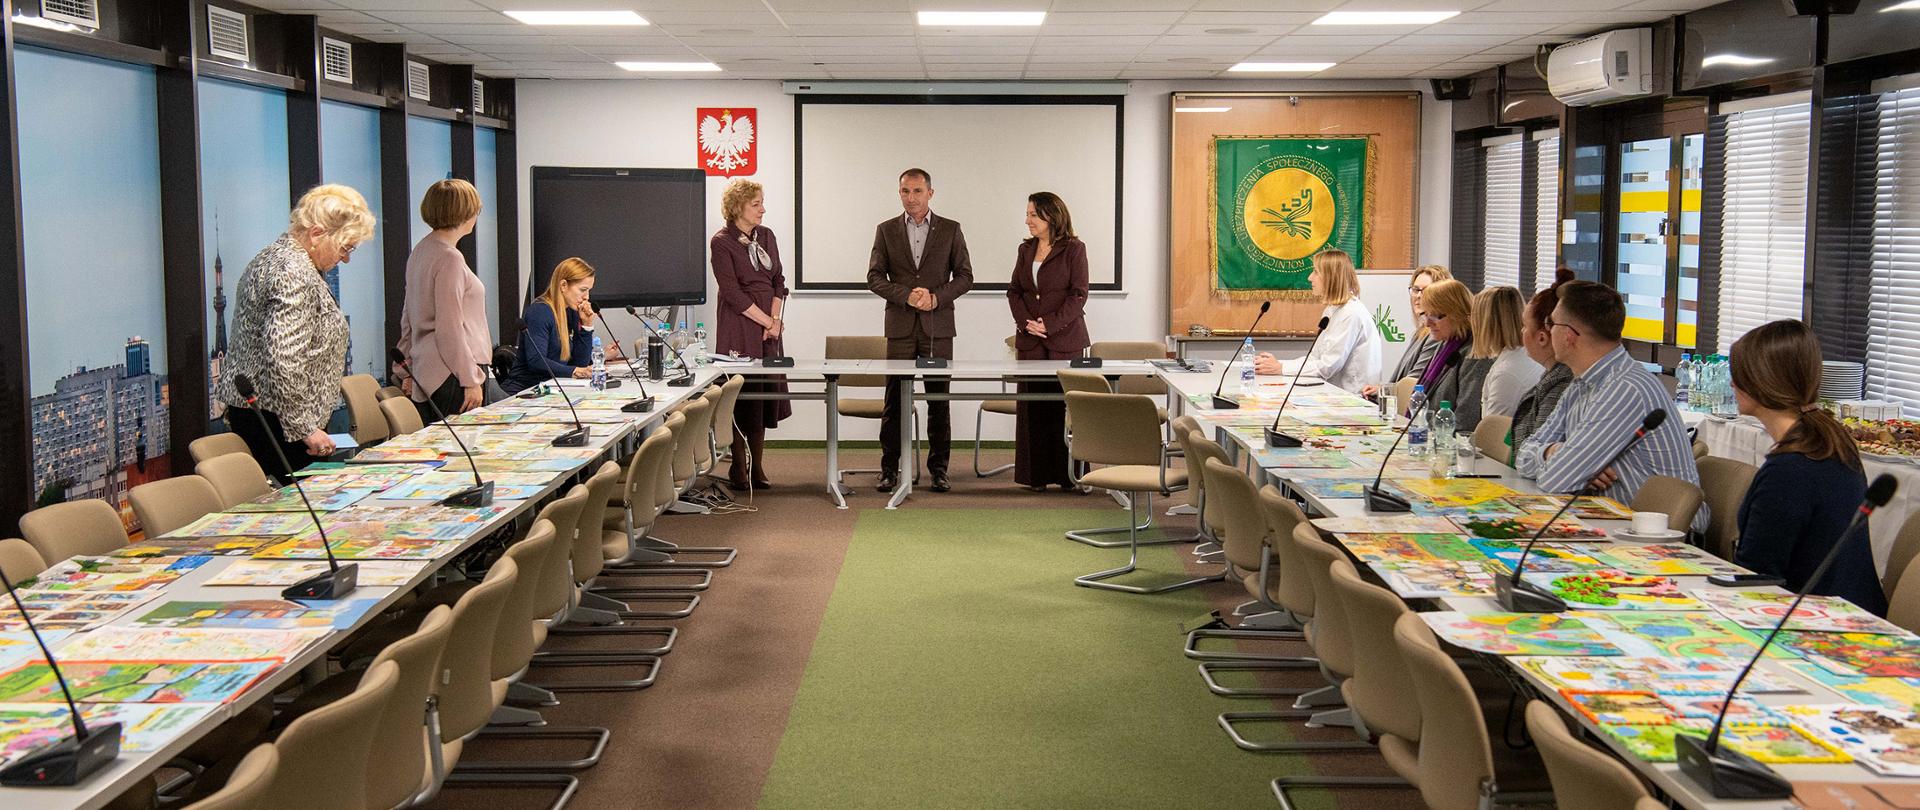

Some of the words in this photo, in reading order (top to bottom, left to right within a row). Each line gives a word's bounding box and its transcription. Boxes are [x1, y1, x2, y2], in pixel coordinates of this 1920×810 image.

[1267, 158, 1335, 187] SPOŁECZNEGO
[1235, 169, 1264, 242] UBEZPIECZENIA
[1247, 243, 1305, 270] ROLNICZEGO
